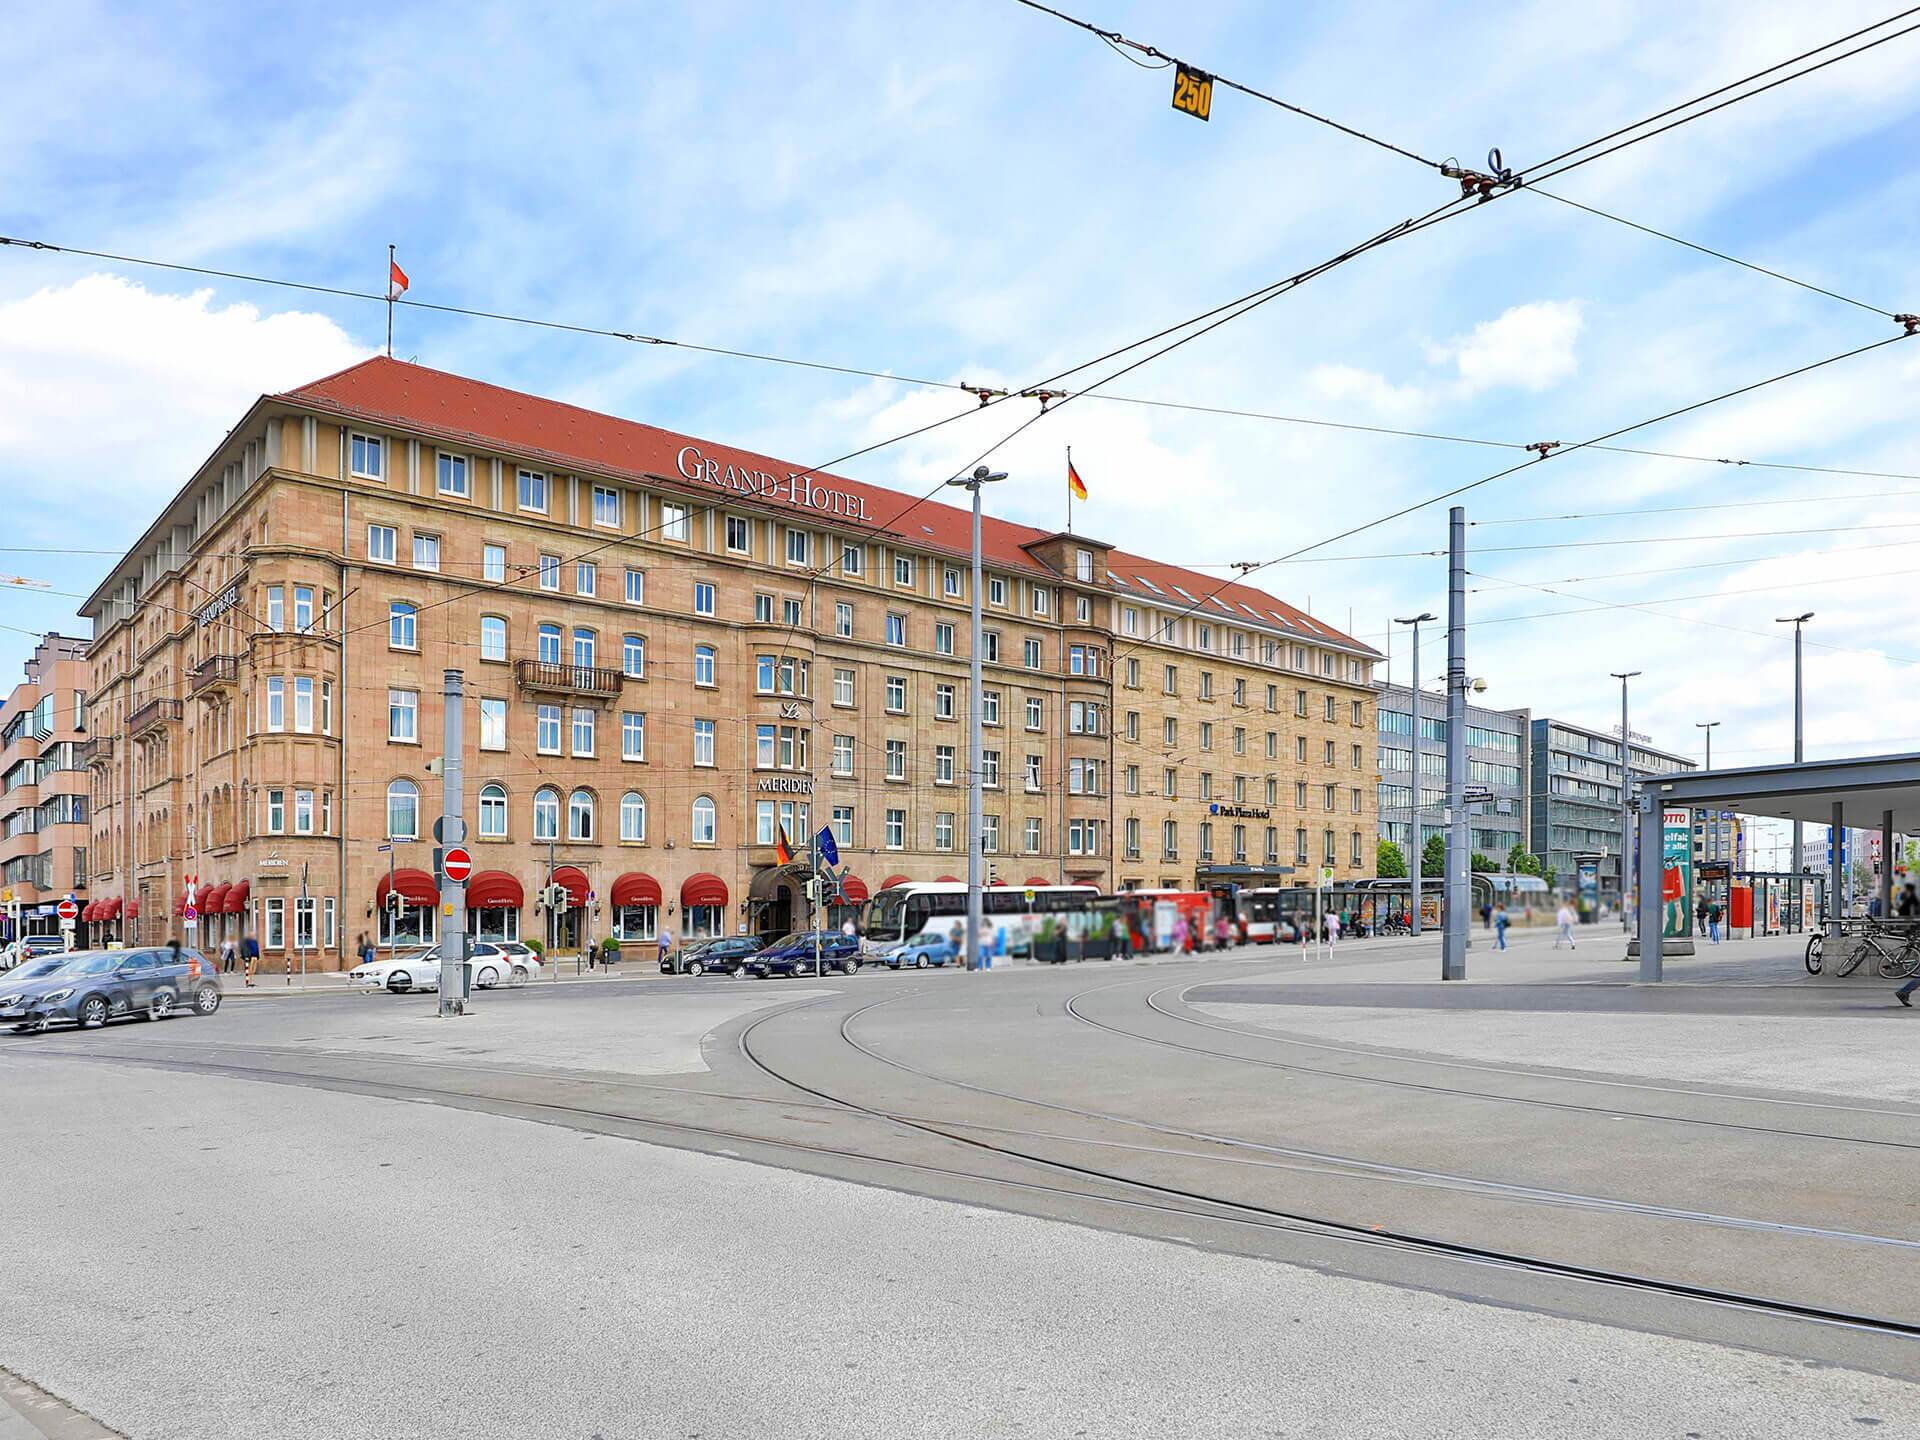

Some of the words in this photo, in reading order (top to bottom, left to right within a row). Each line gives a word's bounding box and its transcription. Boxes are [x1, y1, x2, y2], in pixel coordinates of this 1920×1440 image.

[1174, 72, 1210, 117] 250
[757, 777, 814, 794] MERIDIEN
[1664, 813, 1686, 823] OTTO
